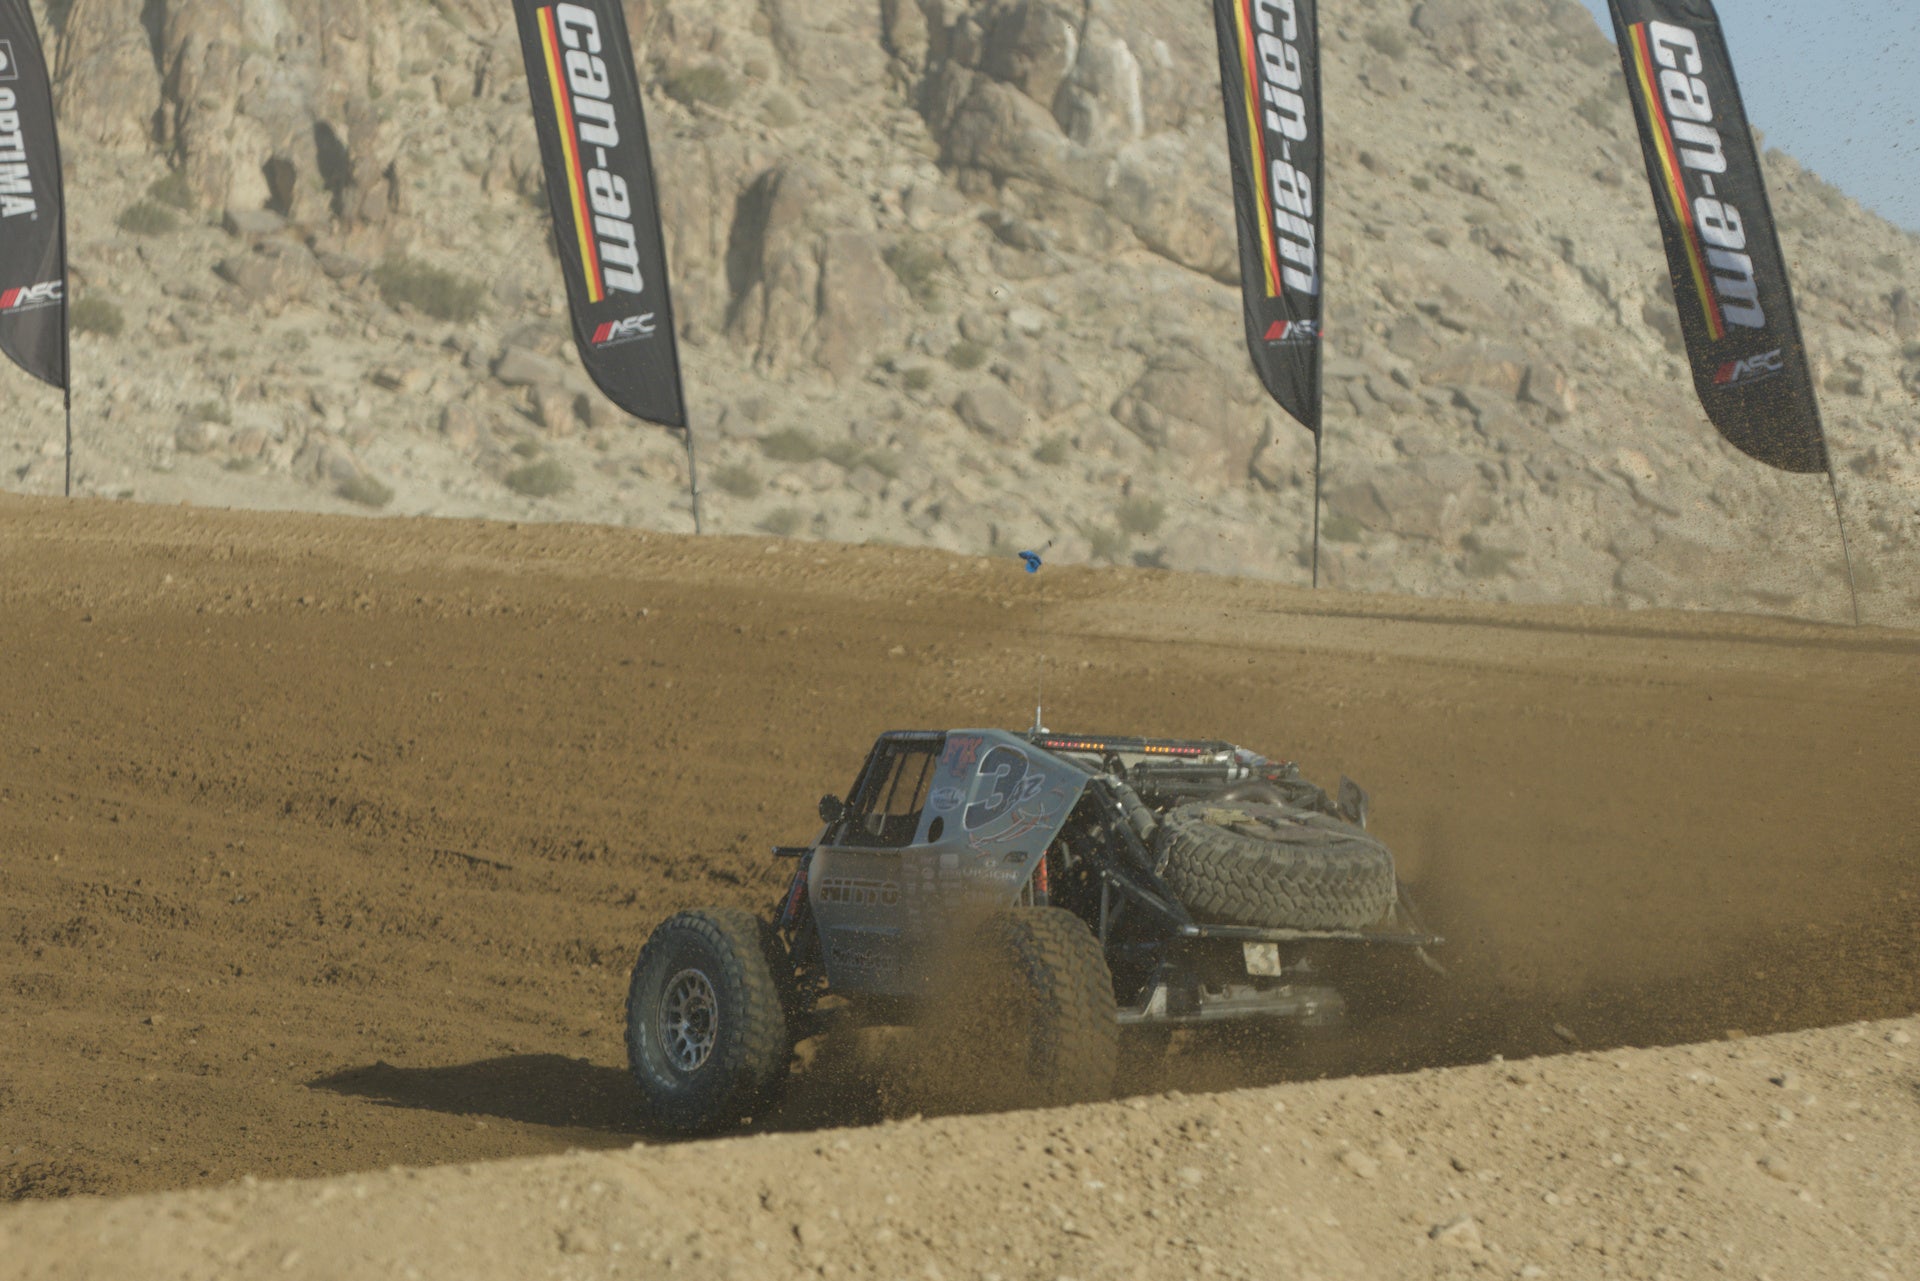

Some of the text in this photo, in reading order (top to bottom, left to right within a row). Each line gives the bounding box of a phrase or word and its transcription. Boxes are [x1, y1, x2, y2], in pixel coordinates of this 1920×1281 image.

[556, 2, 643, 295] can-am
[1254, 0, 1318, 296] can-am
[1650, 19, 1765, 330] can-am
[962, 744, 1031, 832] 3
